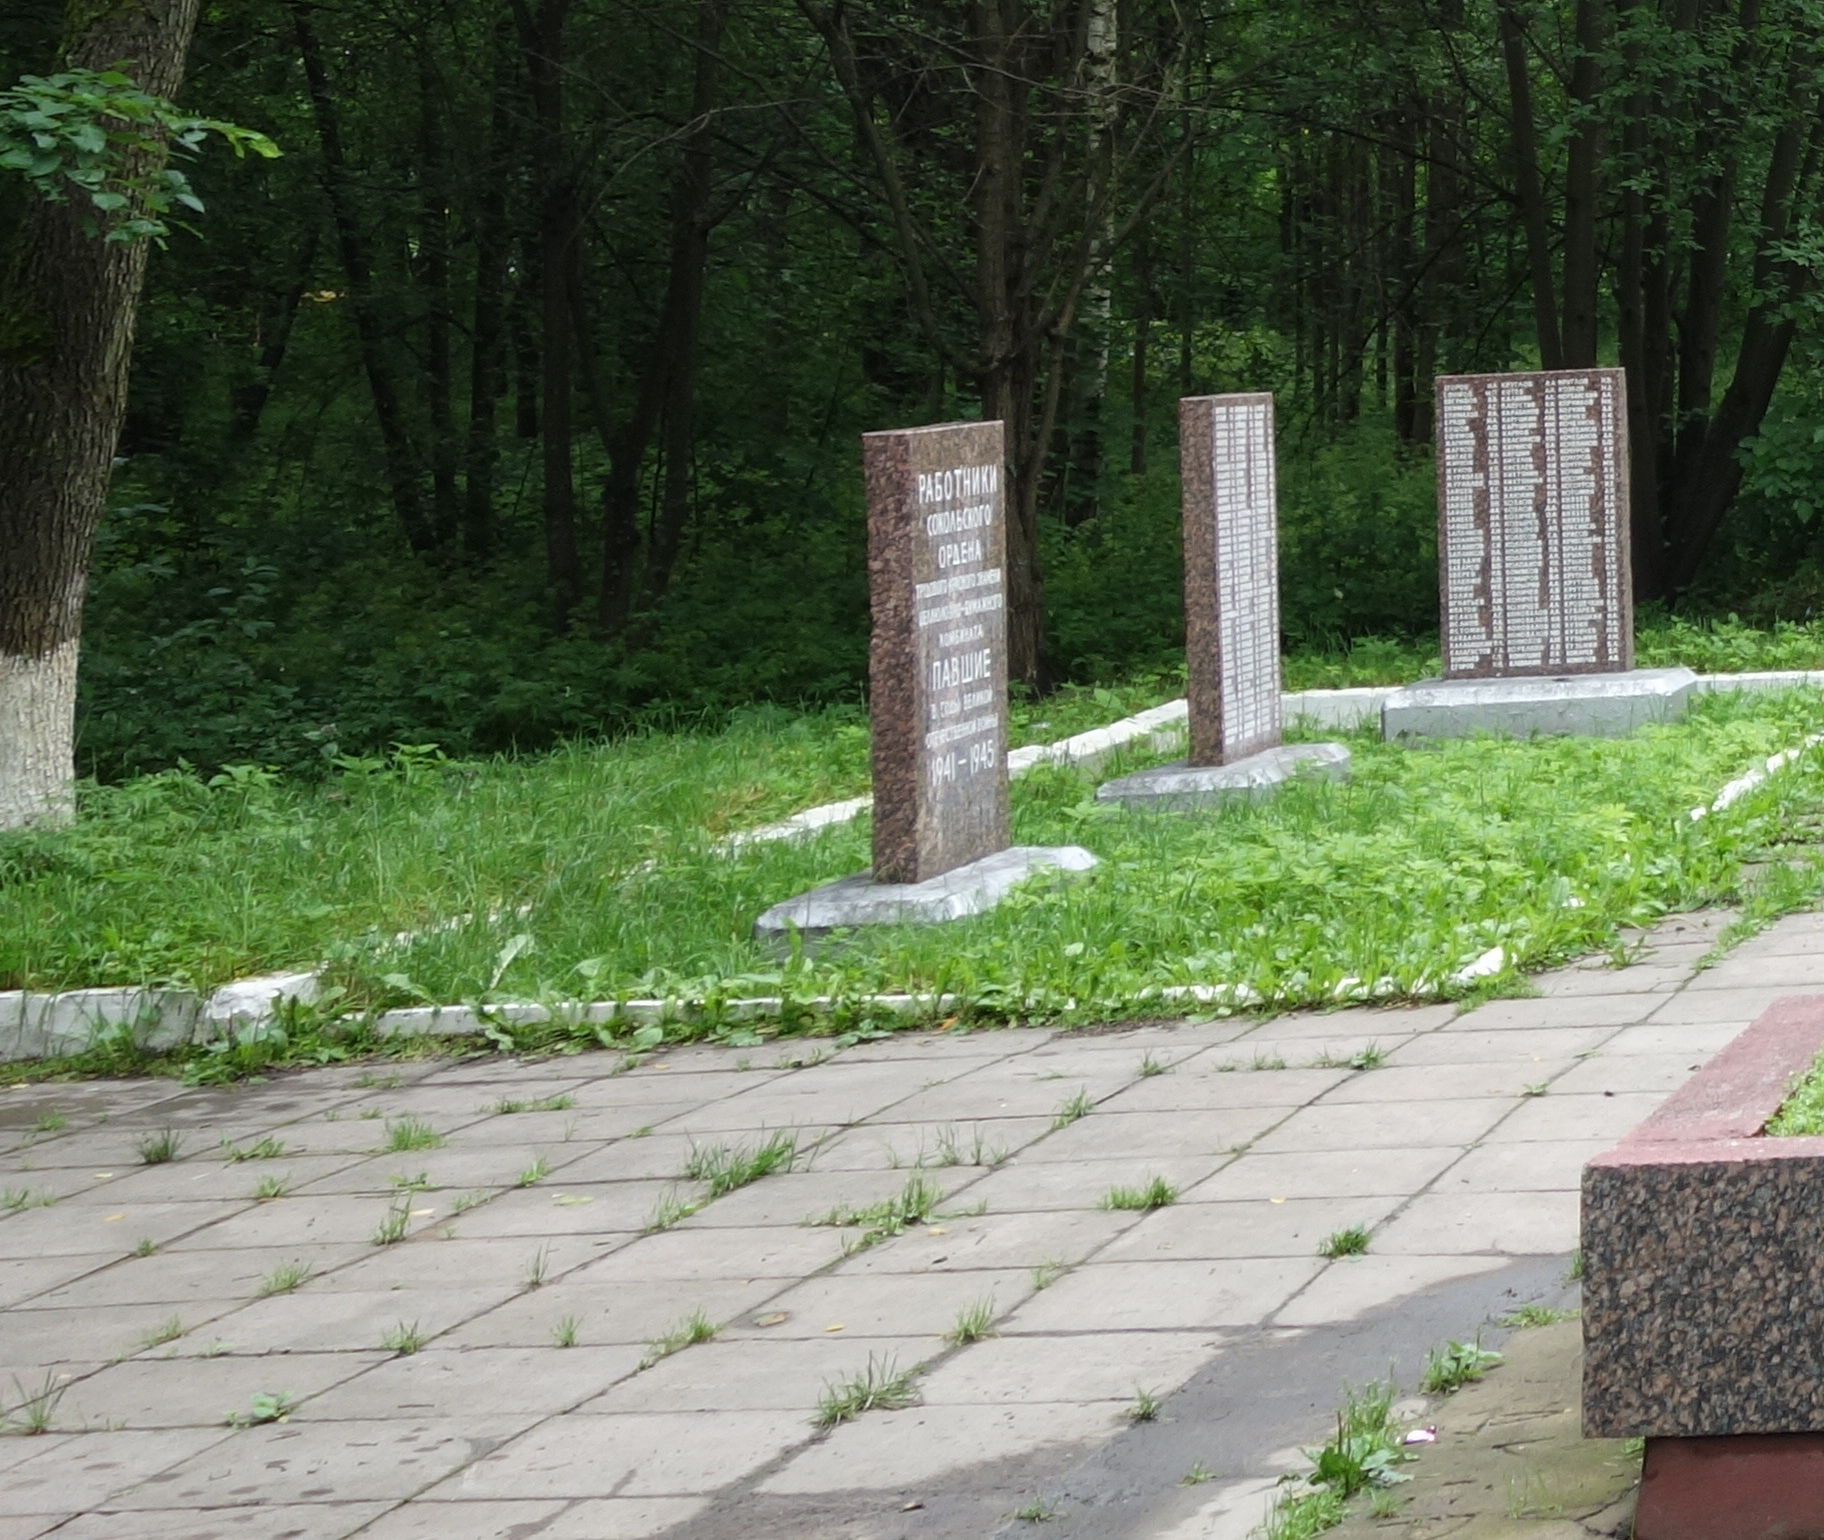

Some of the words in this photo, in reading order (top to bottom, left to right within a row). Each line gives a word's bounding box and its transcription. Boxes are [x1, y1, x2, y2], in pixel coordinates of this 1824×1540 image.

[919, 464, 997, 504] РАБОТНИКИ
[938, 539, 981, 568] ОРДЕНА
[933, 648, 991, 691] ПАВШИЕ
